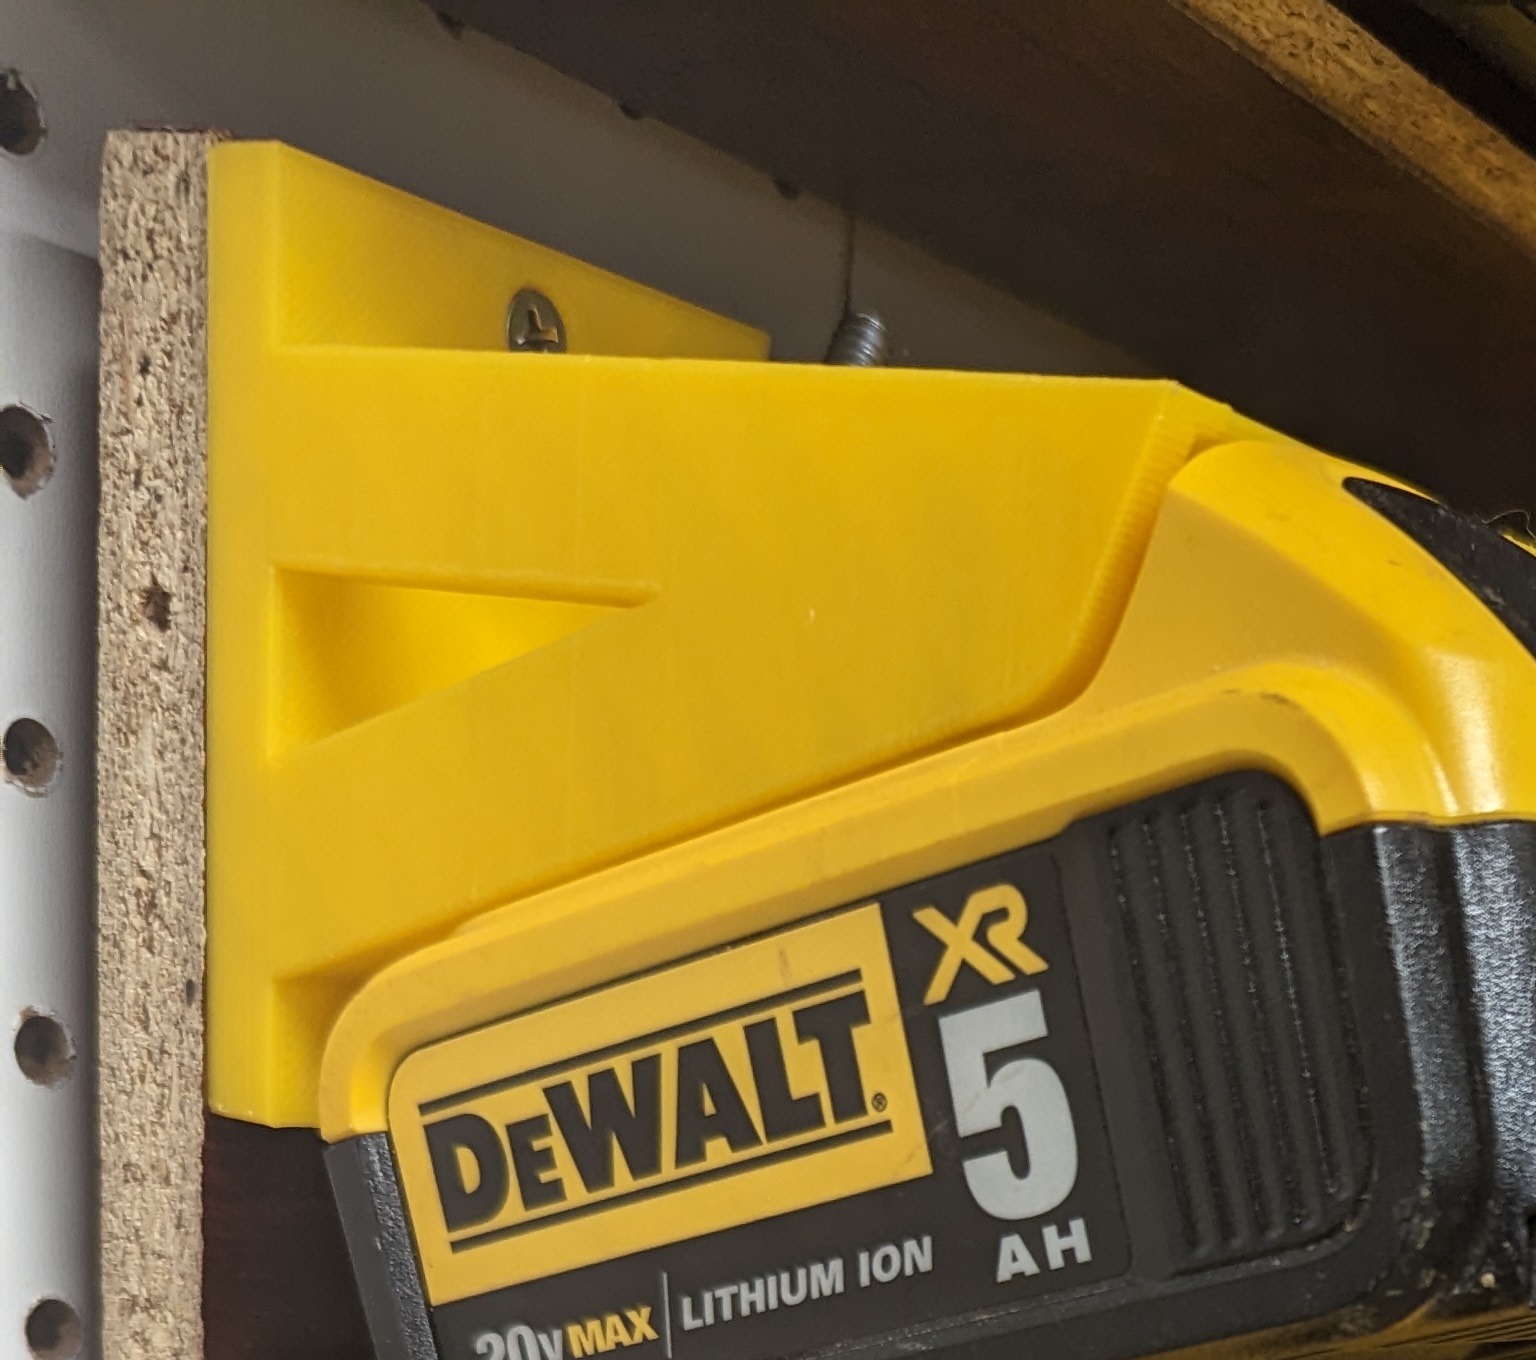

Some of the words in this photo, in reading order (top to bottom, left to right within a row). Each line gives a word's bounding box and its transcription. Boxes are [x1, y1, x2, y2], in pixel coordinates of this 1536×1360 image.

[911, 884, 1049, 1006] XR
[937, 989, 1080, 1221] 5
[681, 1258, 845, 1332] LITHIUM
[858, 1236, 935, 1288] ION
[996, 1218, 1094, 1284] AH
